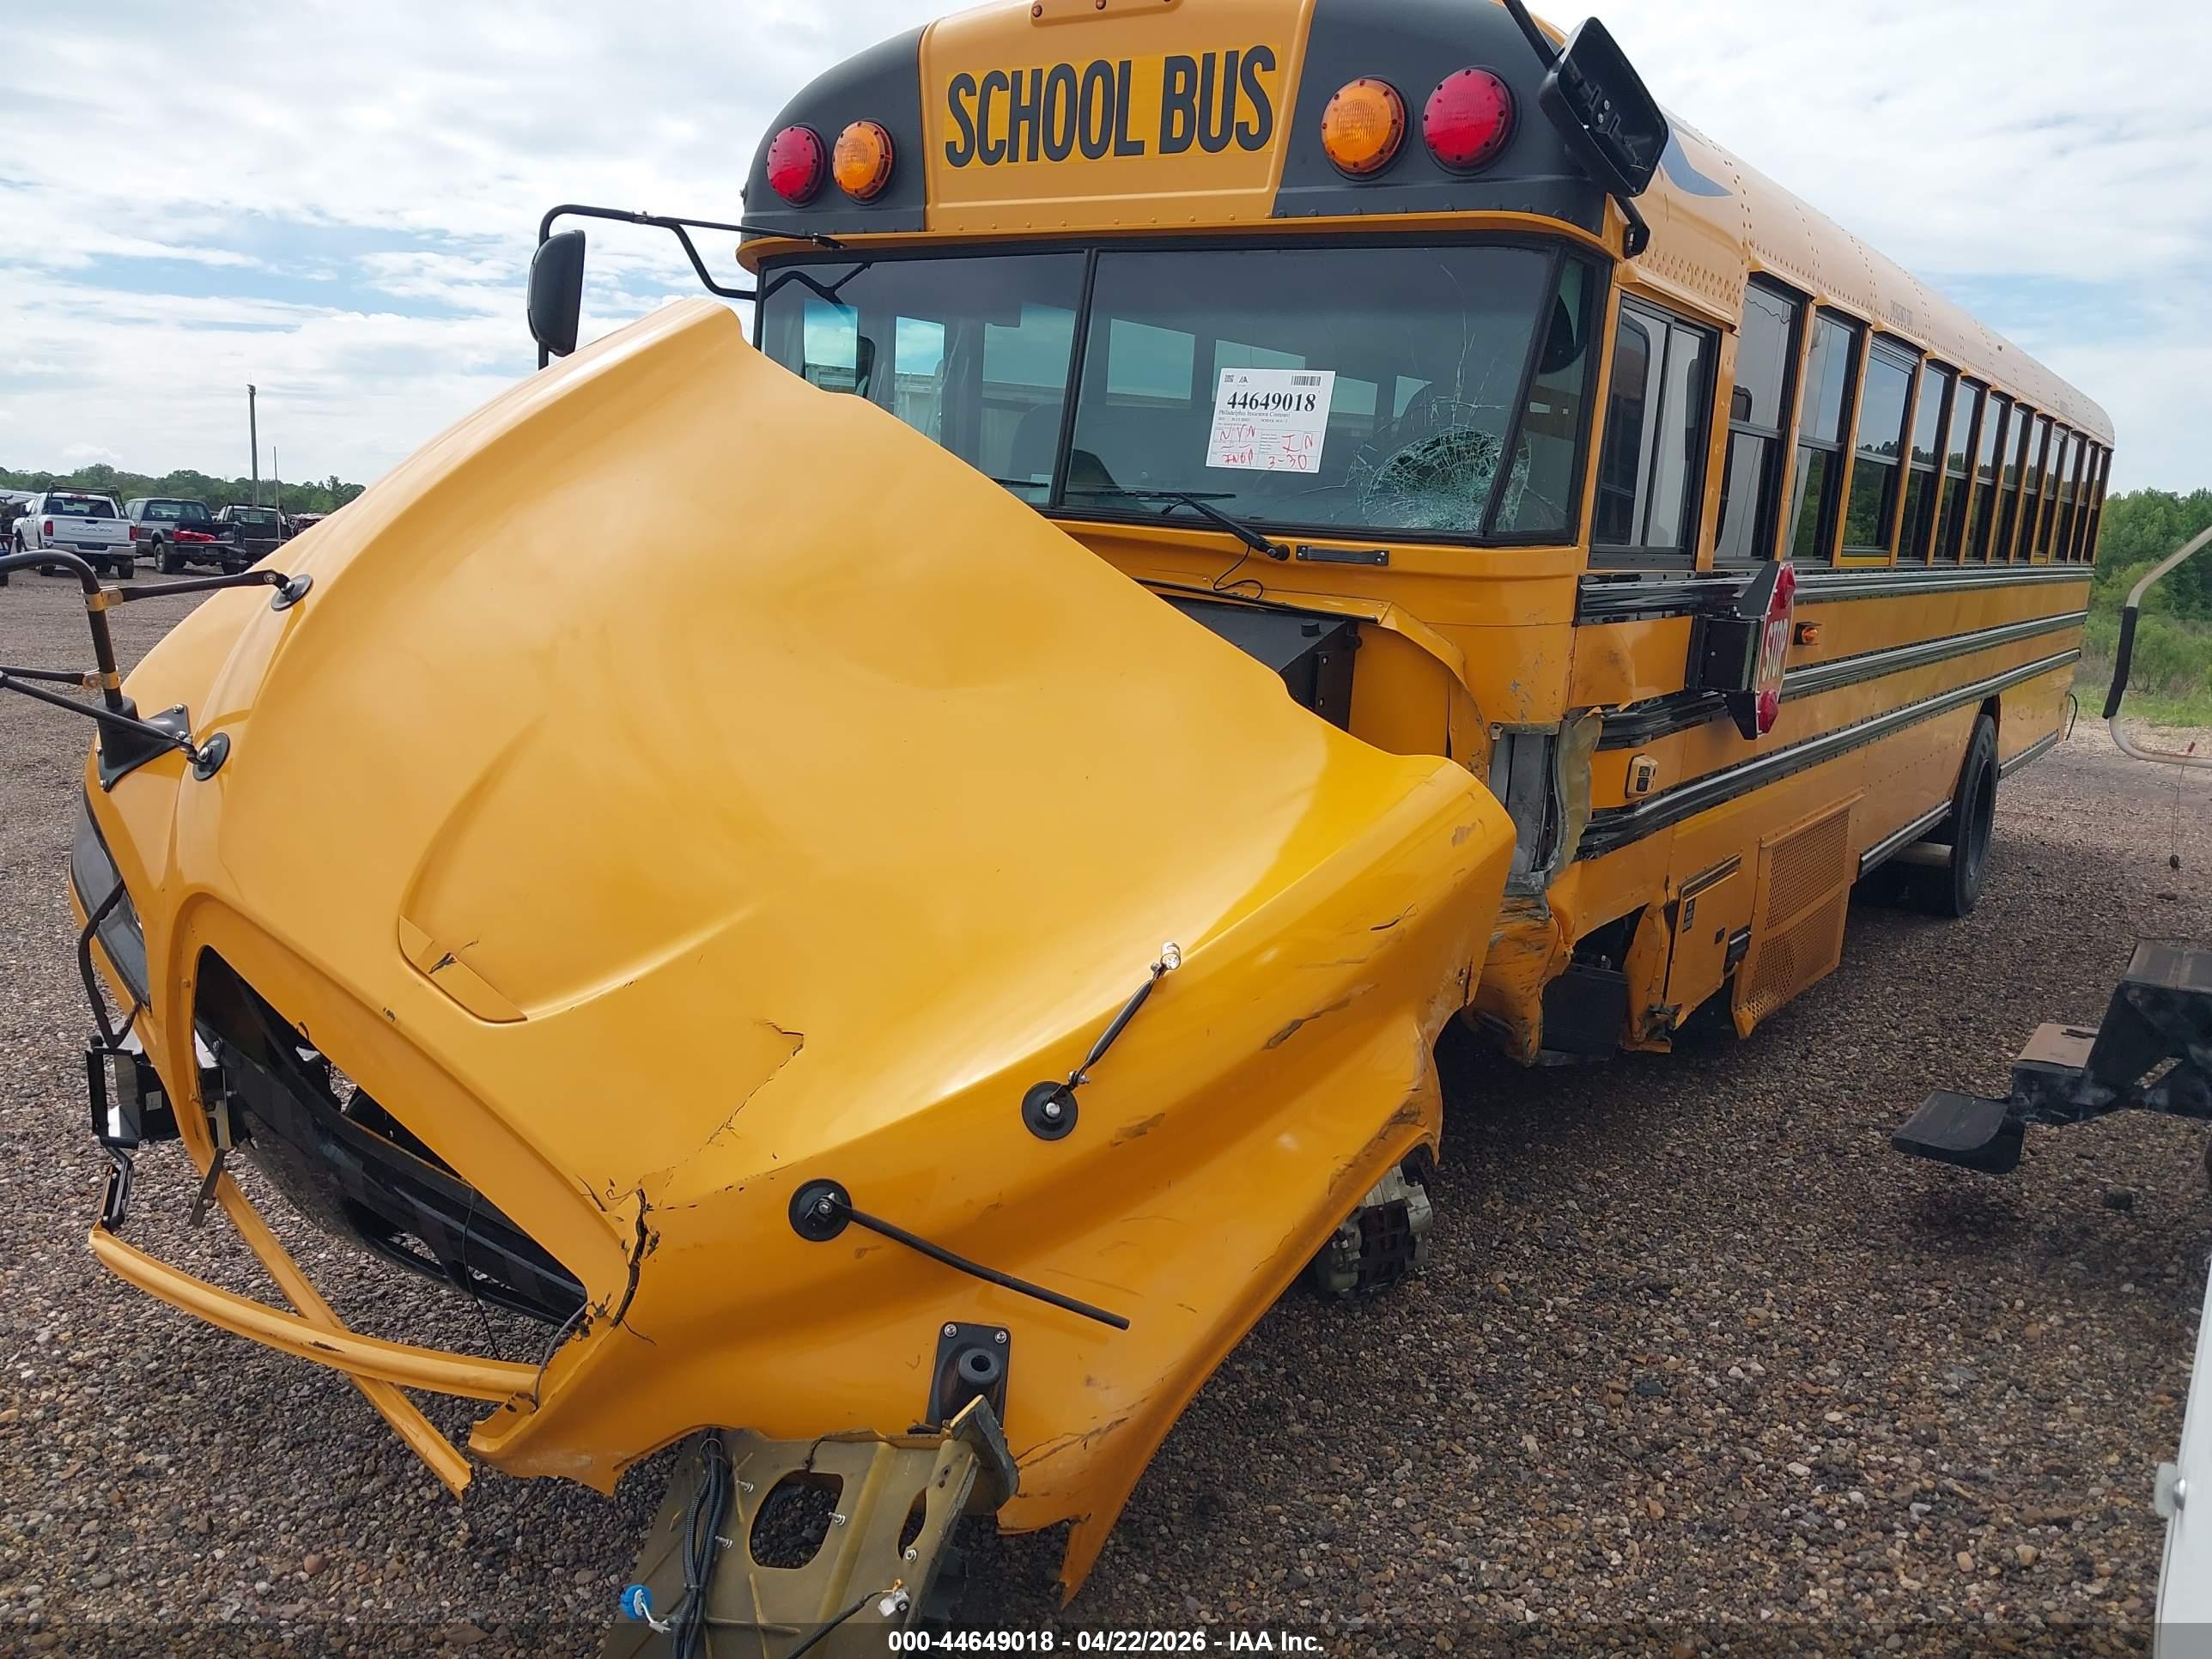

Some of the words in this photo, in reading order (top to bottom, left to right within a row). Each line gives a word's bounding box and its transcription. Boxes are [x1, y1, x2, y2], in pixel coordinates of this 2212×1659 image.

[945, 59, 1145, 167] SCHOOL
[1159, 45, 1276, 154] BUS
[1227, 392, 1316, 412] 44649018
[1762, 618, 1789, 683] STOP
